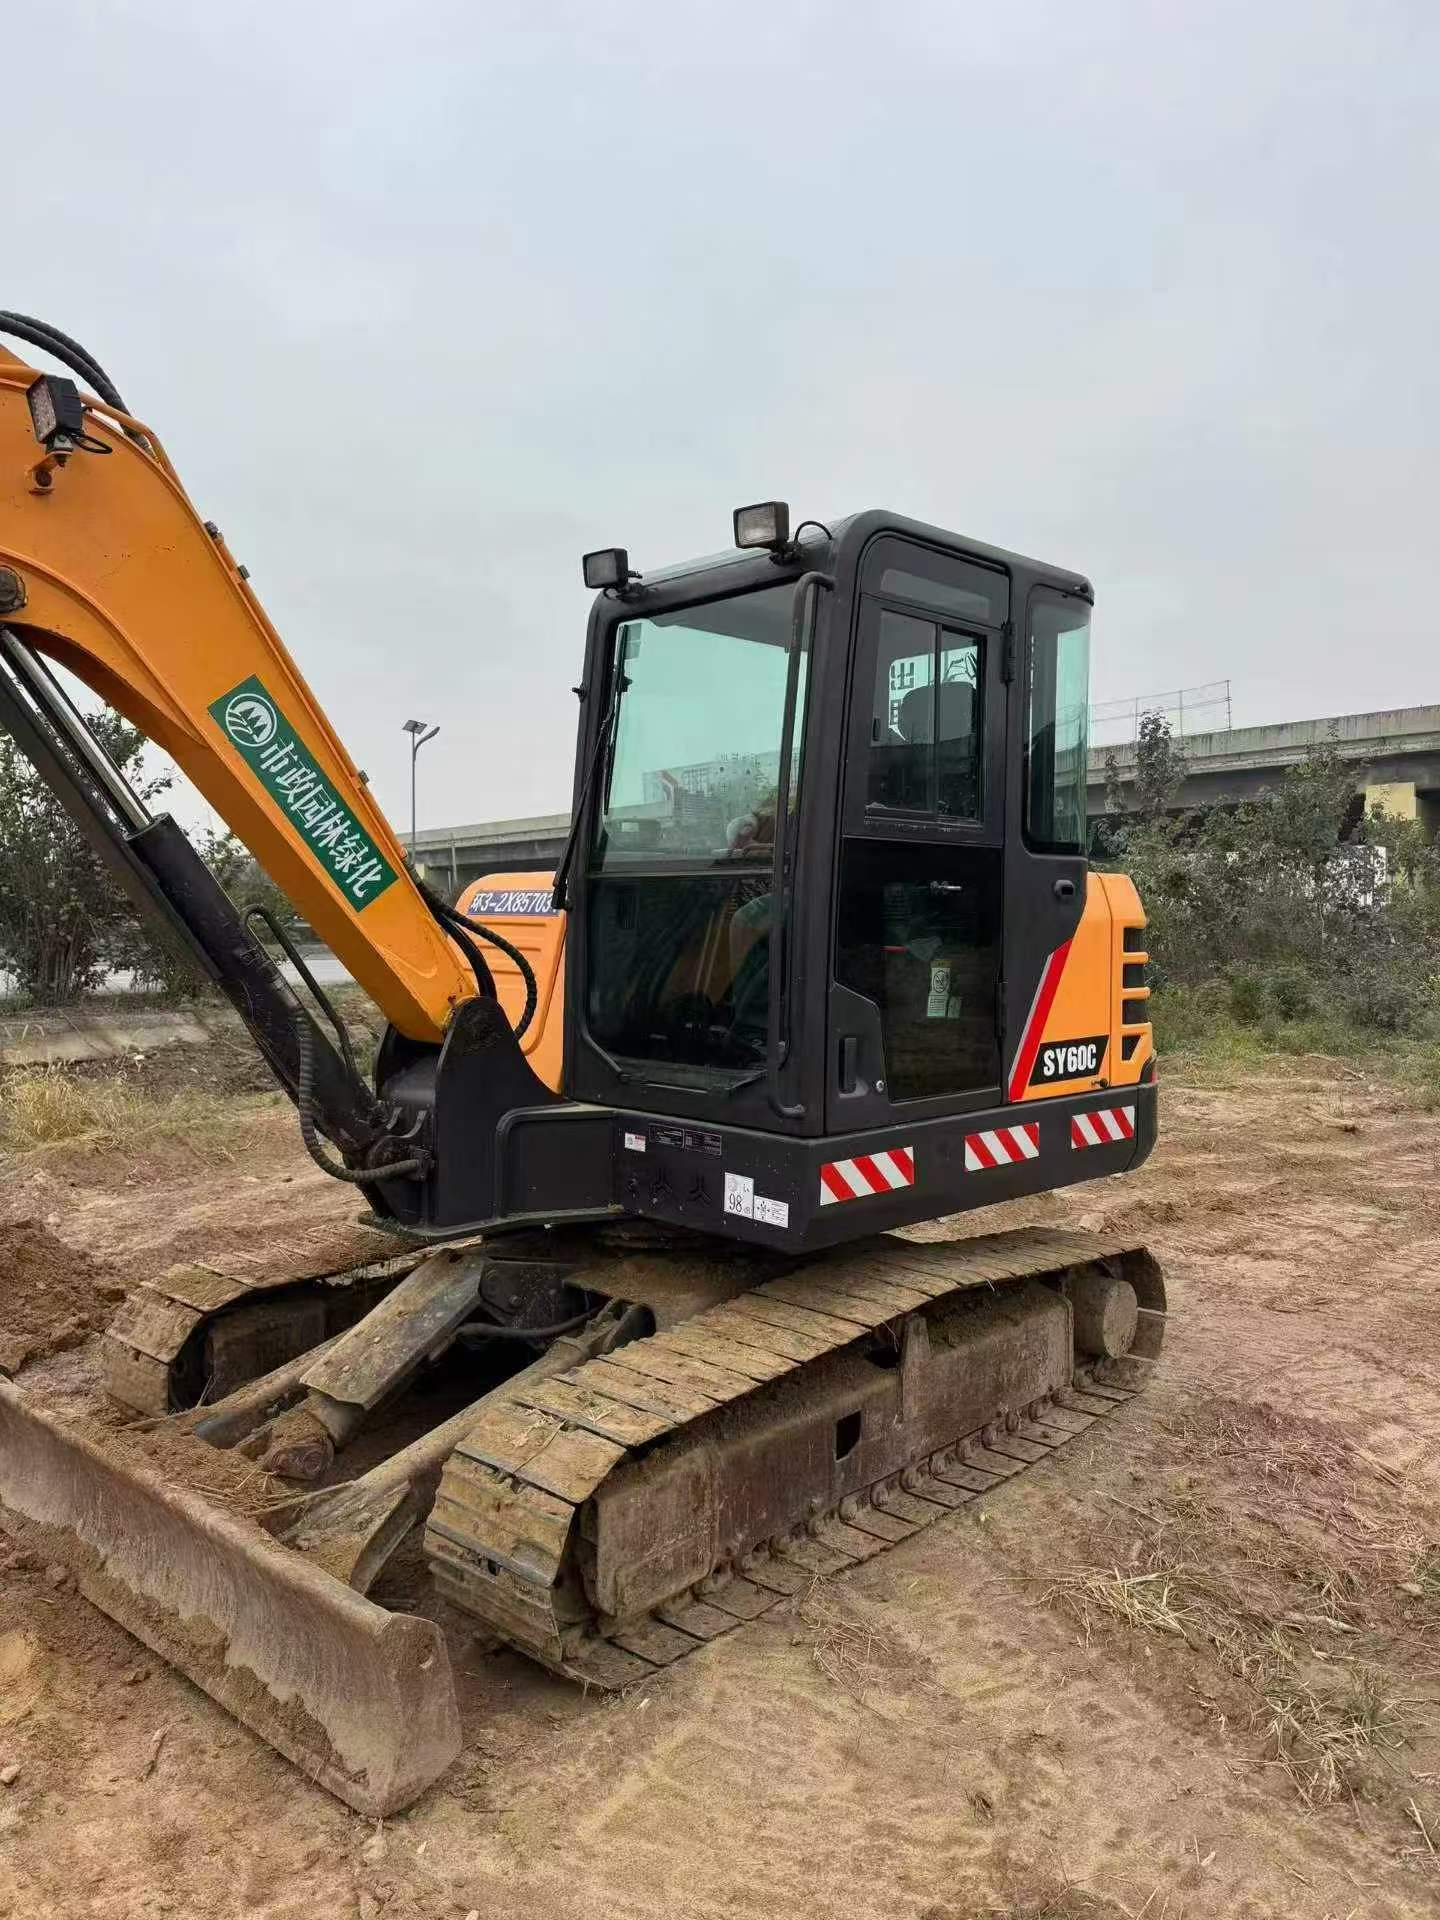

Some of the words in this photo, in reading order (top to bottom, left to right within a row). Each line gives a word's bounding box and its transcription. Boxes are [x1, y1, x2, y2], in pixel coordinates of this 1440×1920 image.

[259, 737, 382, 898] 市政园林绿化
[470, 891, 557, 913] 环3-2X85703
[1043, 1044, 1097, 1077] SY60C
[729, 1192, 743, 1213] 98
